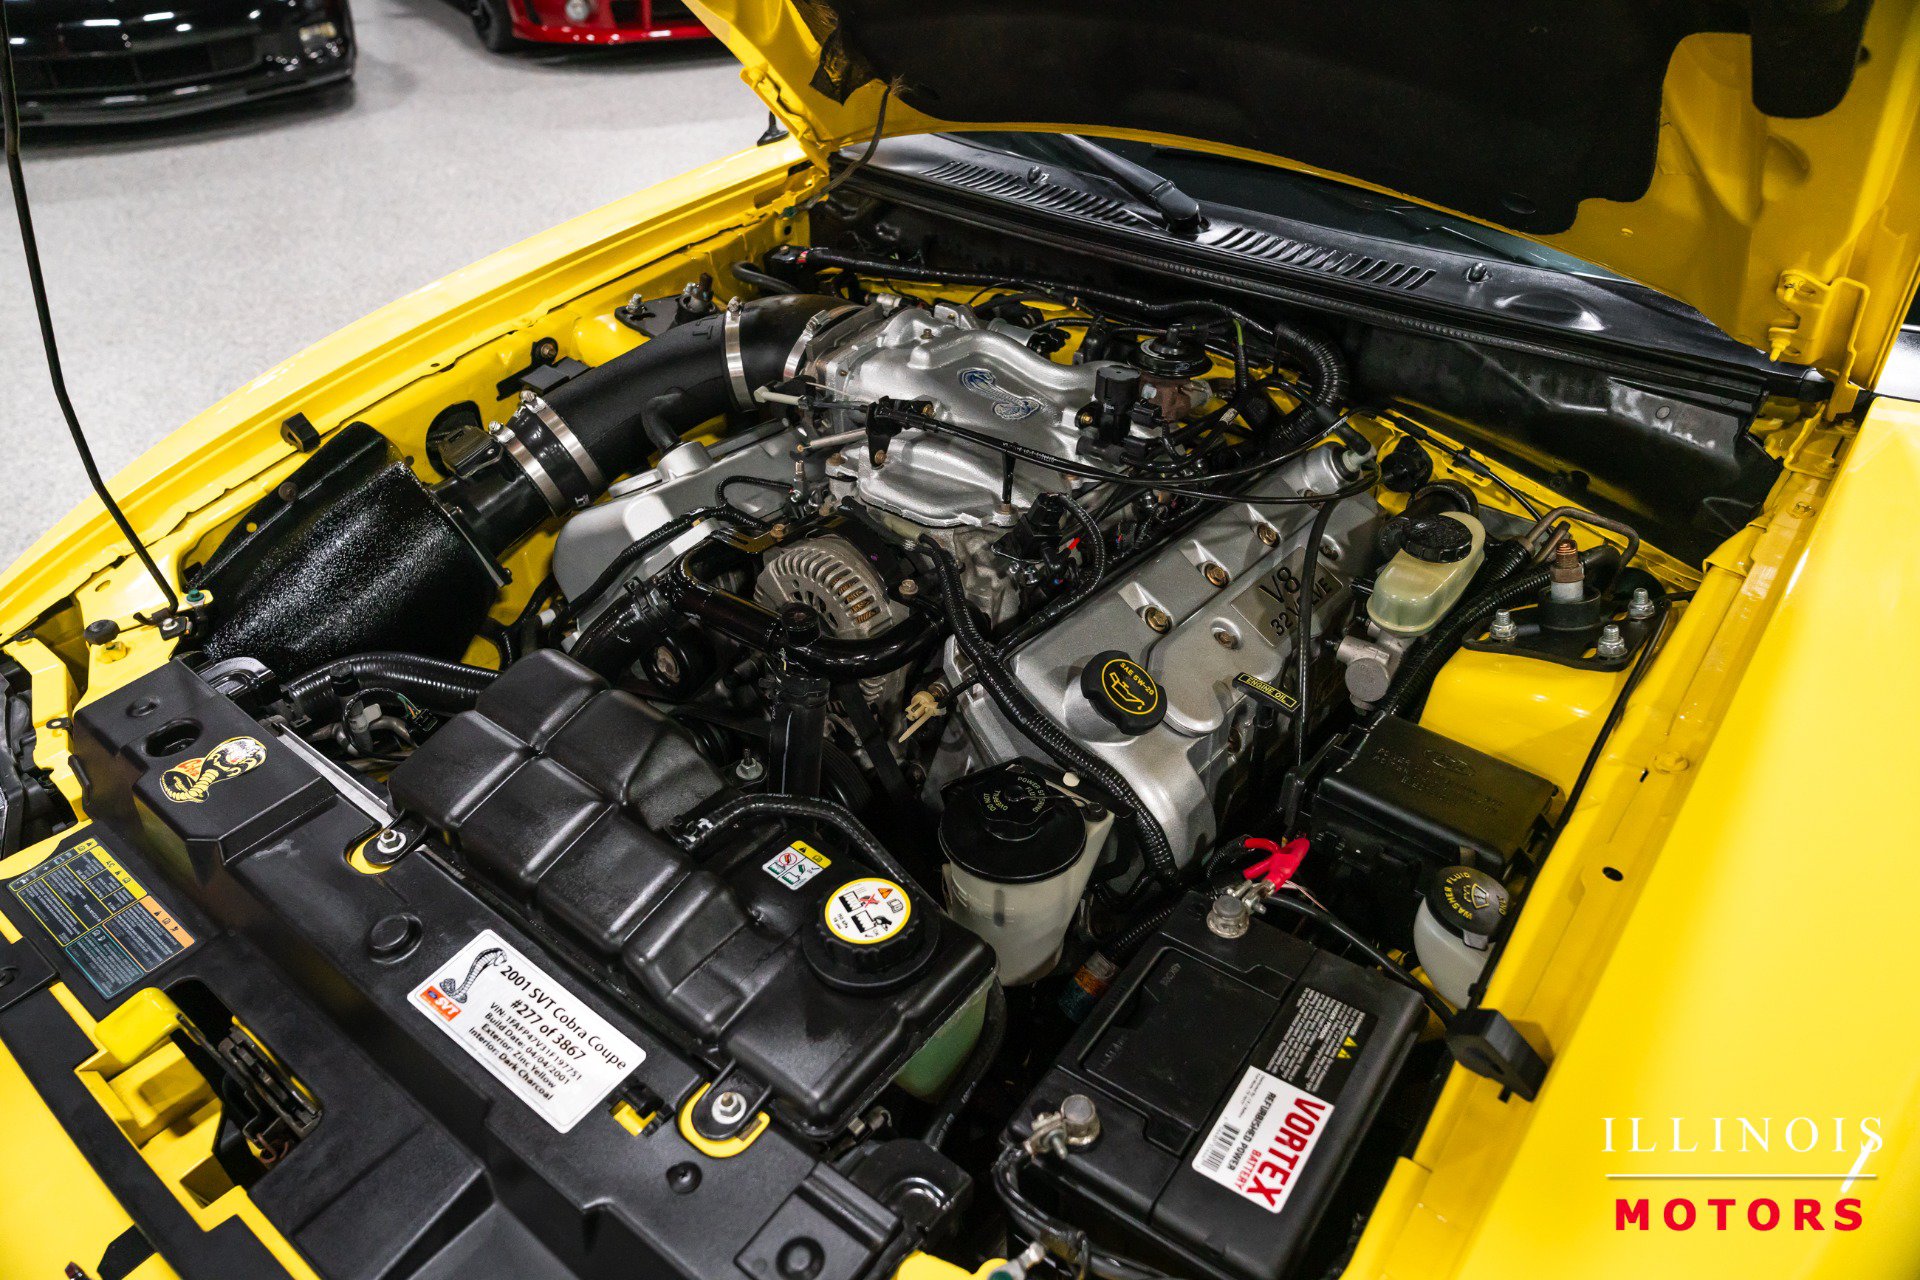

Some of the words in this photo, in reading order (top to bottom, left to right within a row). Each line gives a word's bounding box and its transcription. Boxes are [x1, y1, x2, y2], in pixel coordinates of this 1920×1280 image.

[1259, 567, 1301, 604] V8
[1270, 612, 1293, 636] 32
[1120, 662, 1134, 676] SAE
[1245, 677, 1274, 696] ENGINE
[1274, 690, 1288, 705] OIL
[1017, 776, 1041, 789] POWER
[983, 793, 991, 804] NOT
[986, 803, 996, 812] DO
[1446, 872, 1471, 884] FLUID
[1443, 886, 1473, 920] WASHER
[434, 997, 460, 1014] SVT
[490, 1002, 506, 1018] VIN:
[500, 965, 532, 991] 2001
[528, 988, 557, 1010] SVT
[553, 1007, 587, 1039] Cobra
[587, 1036, 626, 1070] Coupe
[510, 999, 543, 1024] #277
[539, 1024, 558, 1037] of
[552, 1033, 586, 1060] 3867
[468, 1027, 500, 1055] Interior:
[498, 1053, 519, 1071] Dark
[518, 1069, 554, 1100] Charcoal
[481, 1023, 514, 1053] Exterior:
[513, 1050, 530, 1067] Zinc
[531, 1065, 556, 1088] Yellow
[484, 1012, 506, 1031] Build
[504, 1029, 526, 1048] Date:
[525, 1046, 570, 1085] 04/04/2001
[1243, 1091, 1277, 1142] REFURBISHED
[1227, 1142, 1248, 1171] POWER
[1246, 1097, 1326, 1207] VORTEX
[1234, 1149, 1262, 1191] BATTERY
